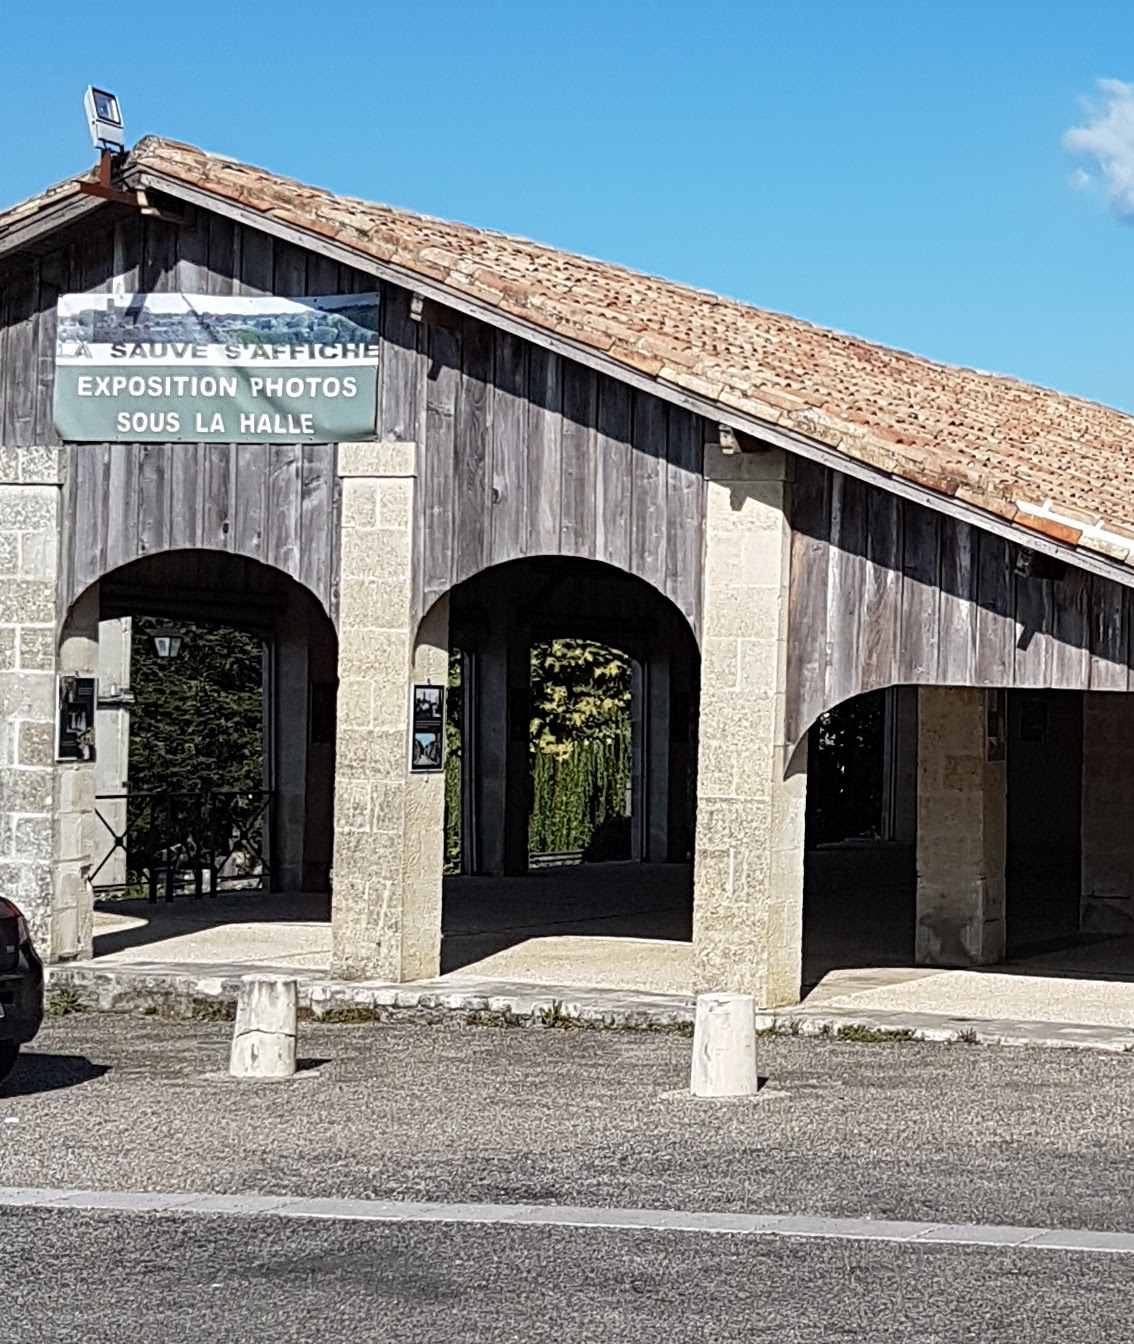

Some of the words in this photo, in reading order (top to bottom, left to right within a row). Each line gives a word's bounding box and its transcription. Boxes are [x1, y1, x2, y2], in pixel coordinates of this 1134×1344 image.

[110, 341, 209, 359] SAUVE
[224, 342, 380, 360] S'AFFICHE
[77, 375, 238, 398] EXPOSITION
[251, 376, 358, 399] PHOTOS
[116, 412, 181, 434] SOUS
[195, 413, 225, 434] LA
[240, 413, 315, 435] HALLE
